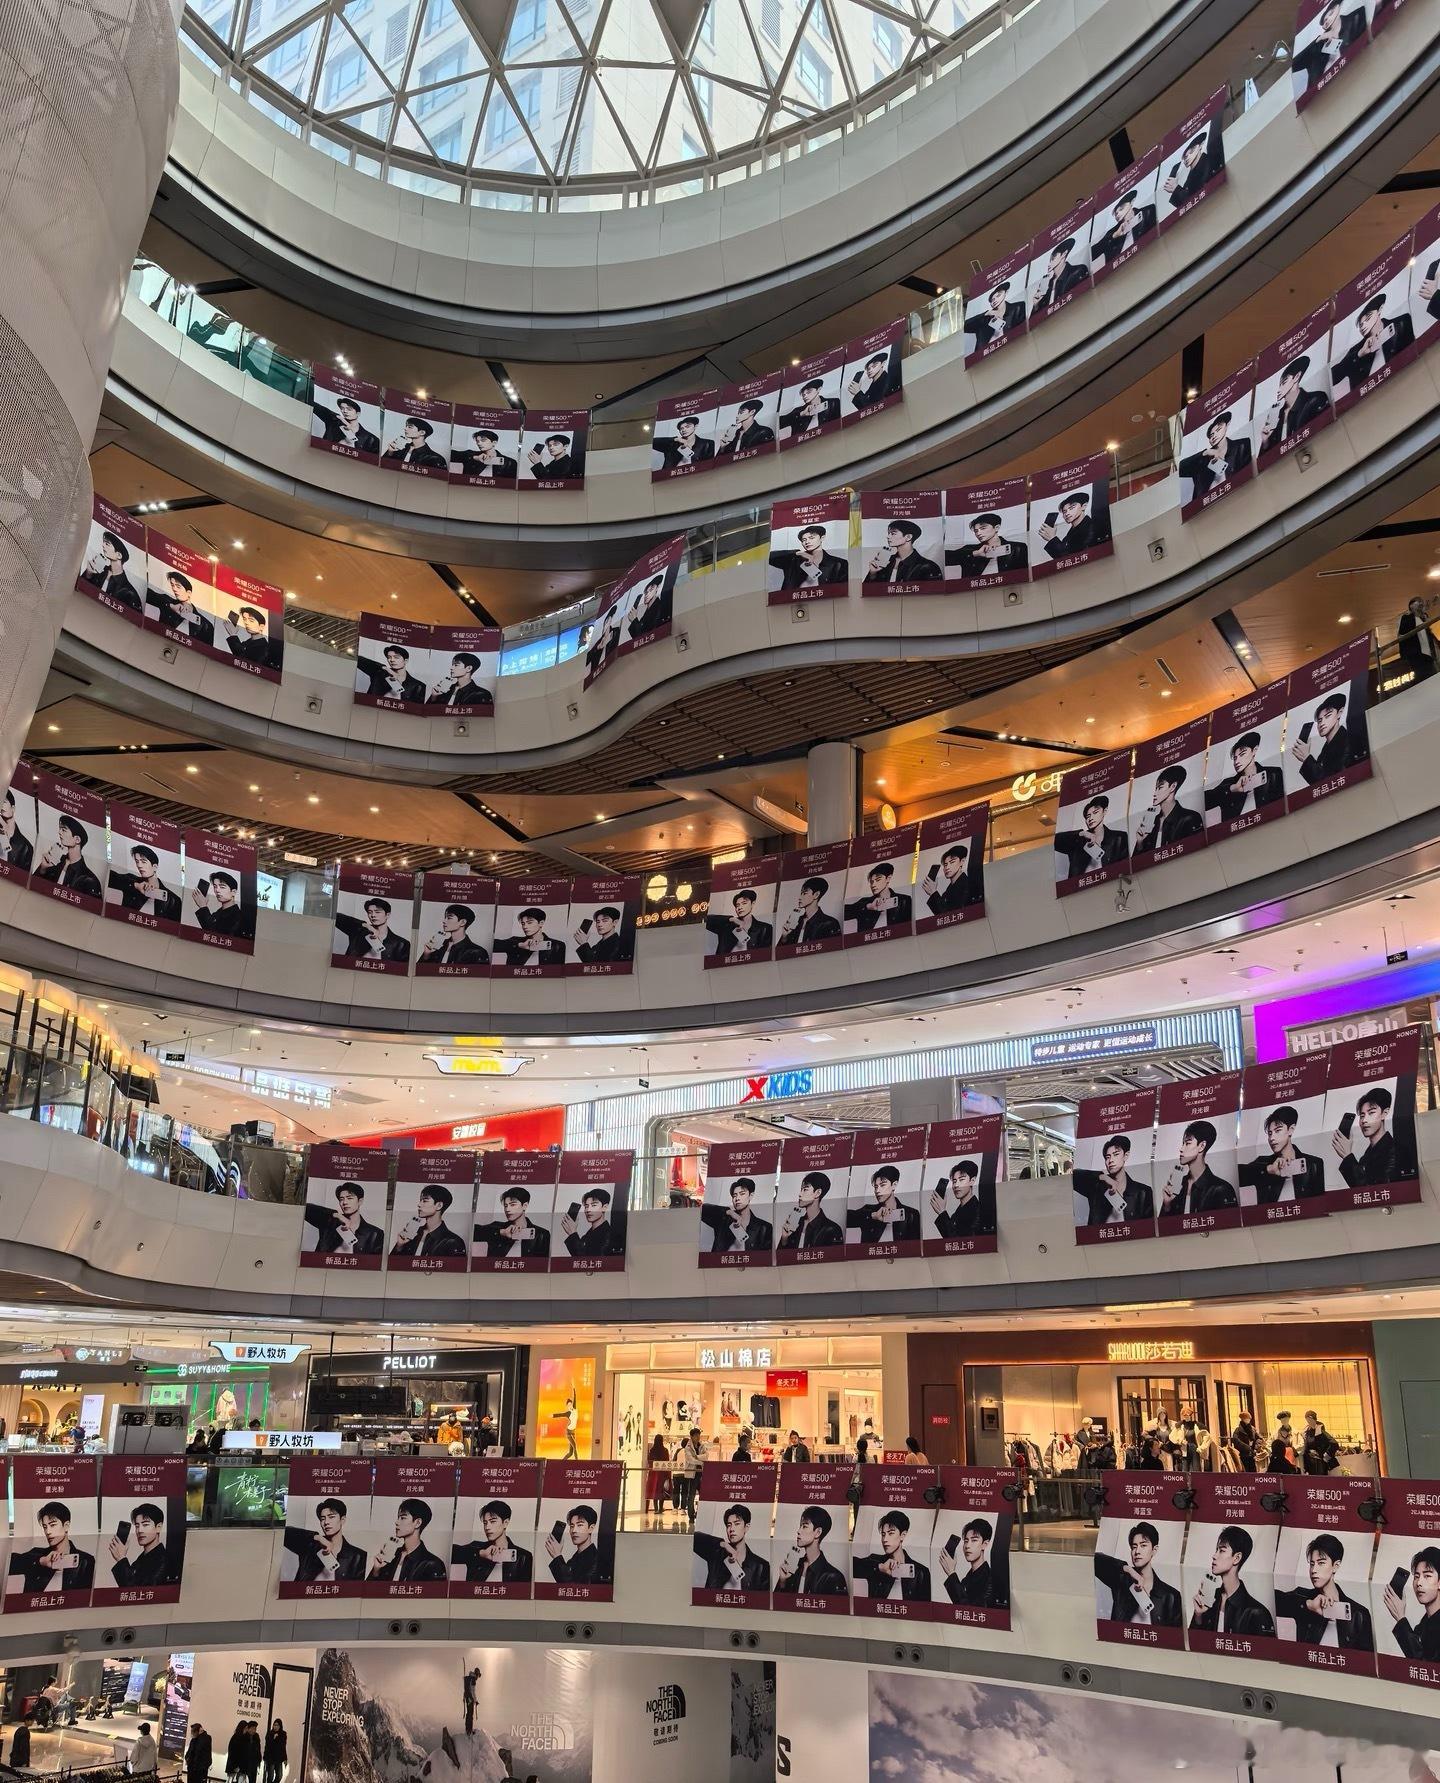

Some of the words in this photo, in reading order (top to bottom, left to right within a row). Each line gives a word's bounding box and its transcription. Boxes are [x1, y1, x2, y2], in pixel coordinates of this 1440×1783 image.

[1360, 367, 1391, 397] 新品上市
[1280, 428, 1310, 455] 新品上市
[331, 445, 359, 457] 新品上市
[1203, 483, 1232, 507] 新品上市
[1056, 554, 1089, 570] 新品上市
[970, 576, 1003, 588] 新品上市
[792, 589, 824, 600] 新品上市
[887, 585, 920, 594] 新品上市
[99, 593, 124, 613] 新品上市
[166, 629, 193, 647] 新品上市
[234, 659, 261, 674] 新品上市
[377, 699, 405, 710] 新品上市
[1313, 777, 1346, 798] 新品上市
[1231, 814, 1262, 833] 新品上市
[1154, 845, 1184, 861] 新品上市
[1079, 872, 1107, 888] 新品上市
[53, 887, 82, 905] 新品上市
[128, 913, 158, 928] 新品上市
[937, 913, 964, 926] 新品上市
[203, 933, 232, 948] 新品上市
[864, 930, 891, 941] 新品上市
[796, 943, 823, 954] 新品上市
[725, 954, 751, 964] 新品上市
[355, 960, 385, 971] 新品上市
[439, 966, 468, 975] 新品上市
[584, 965, 612, 973] 新品上市
[514, 968, 542, 976] 新品上市
[1396, 1029, 1418, 1039] HONOR
[1306, 1053, 1327, 1063] HONOR
[1135, 1089, 1155, 1098] HONOR
[1353, 1189, 1390, 1205] 新品上市
[1267, 1204, 1301, 1219] 新品上市
[1183, 1215, 1215, 1229] 新品上市
[1099, 1226, 1131, 1239] 新品上市
[869, 1246, 898, 1256] 新品上市
[945, 1241, 975, 1252] 新品上市
[325, 1256, 358, 1266] 新品上市
[721, 1255, 750, 1265] 新品上市
[797, 1251, 825, 1261] 新品上市
[412, 1259, 443, 1269] 新品上市
[494, 1261, 525, 1270] 新品上市
[573, 1260, 603, 1269] 新品上市
[248, 1347, 286, 1359] 野人牧坊
[701, 1348, 771, 1368] 松山棉店
[383, 1356, 436, 1371] PELLIOT
[269, 1435, 314, 1448] 野人牧坊
[36, 1466, 67, 1476] 荣耀500
[125, 1466, 157, 1475] 荣耀500
[1126, 1485, 1155, 1496] 荣耀500
[1215, 1485, 1248, 1497] 荣耀500
[1307, 1489, 1341, 1501] 荣耀500
[120, 1592, 154, 1601] 新品上市
[305, 1586, 340, 1595] 新品上市
[390, 1586, 423, 1595] 新品上市
[474, 1586, 506, 1596] 新品上市
[558, 1588, 590, 1597] 新品上市
[30, 1597, 65, 1608] 新品上市
[716, 1594, 746, 1605] 新品上市
[796, 1598, 827, 1609] 新品上市
[877, 1603, 908, 1615] 新品上市
[955, 1610, 986, 1623] 新品上市
[1124, 1629, 1158, 1642] 新品上市
[1215, 1639, 1252, 1652] 新品上市
[1308, 1651, 1346, 1666] 新品上市
[246, 1663, 260, 1674] THE
[1409, 1667, 1440, 1682] 新品上
[233, 1672, 259, 1684] NORTH
[239, 1684, 257, 1697] FACE
[323, 1687, 349, 1700] NEVER
[658, 1685, 673, 1697] THE
[237, 1699, 262, 1710] 敬请期待
[323, 1698, 342, 1710] STOP
[646, 1696, 673, 1712] NORTH
[322, 1710, 365, 1727] EXPLORING
[530, 1713, 553, 1726] THE
[653, 1709, 673, 1723] FACE
[511, 1725, 552, 1737] NORTH
[654, 1724, 679, 1736] 敬请期待
[522, 1737, 552, 1750] FACE
[653, 1737, 667, 1746] COMING
[668, 1736, 679, 1744] SOON
